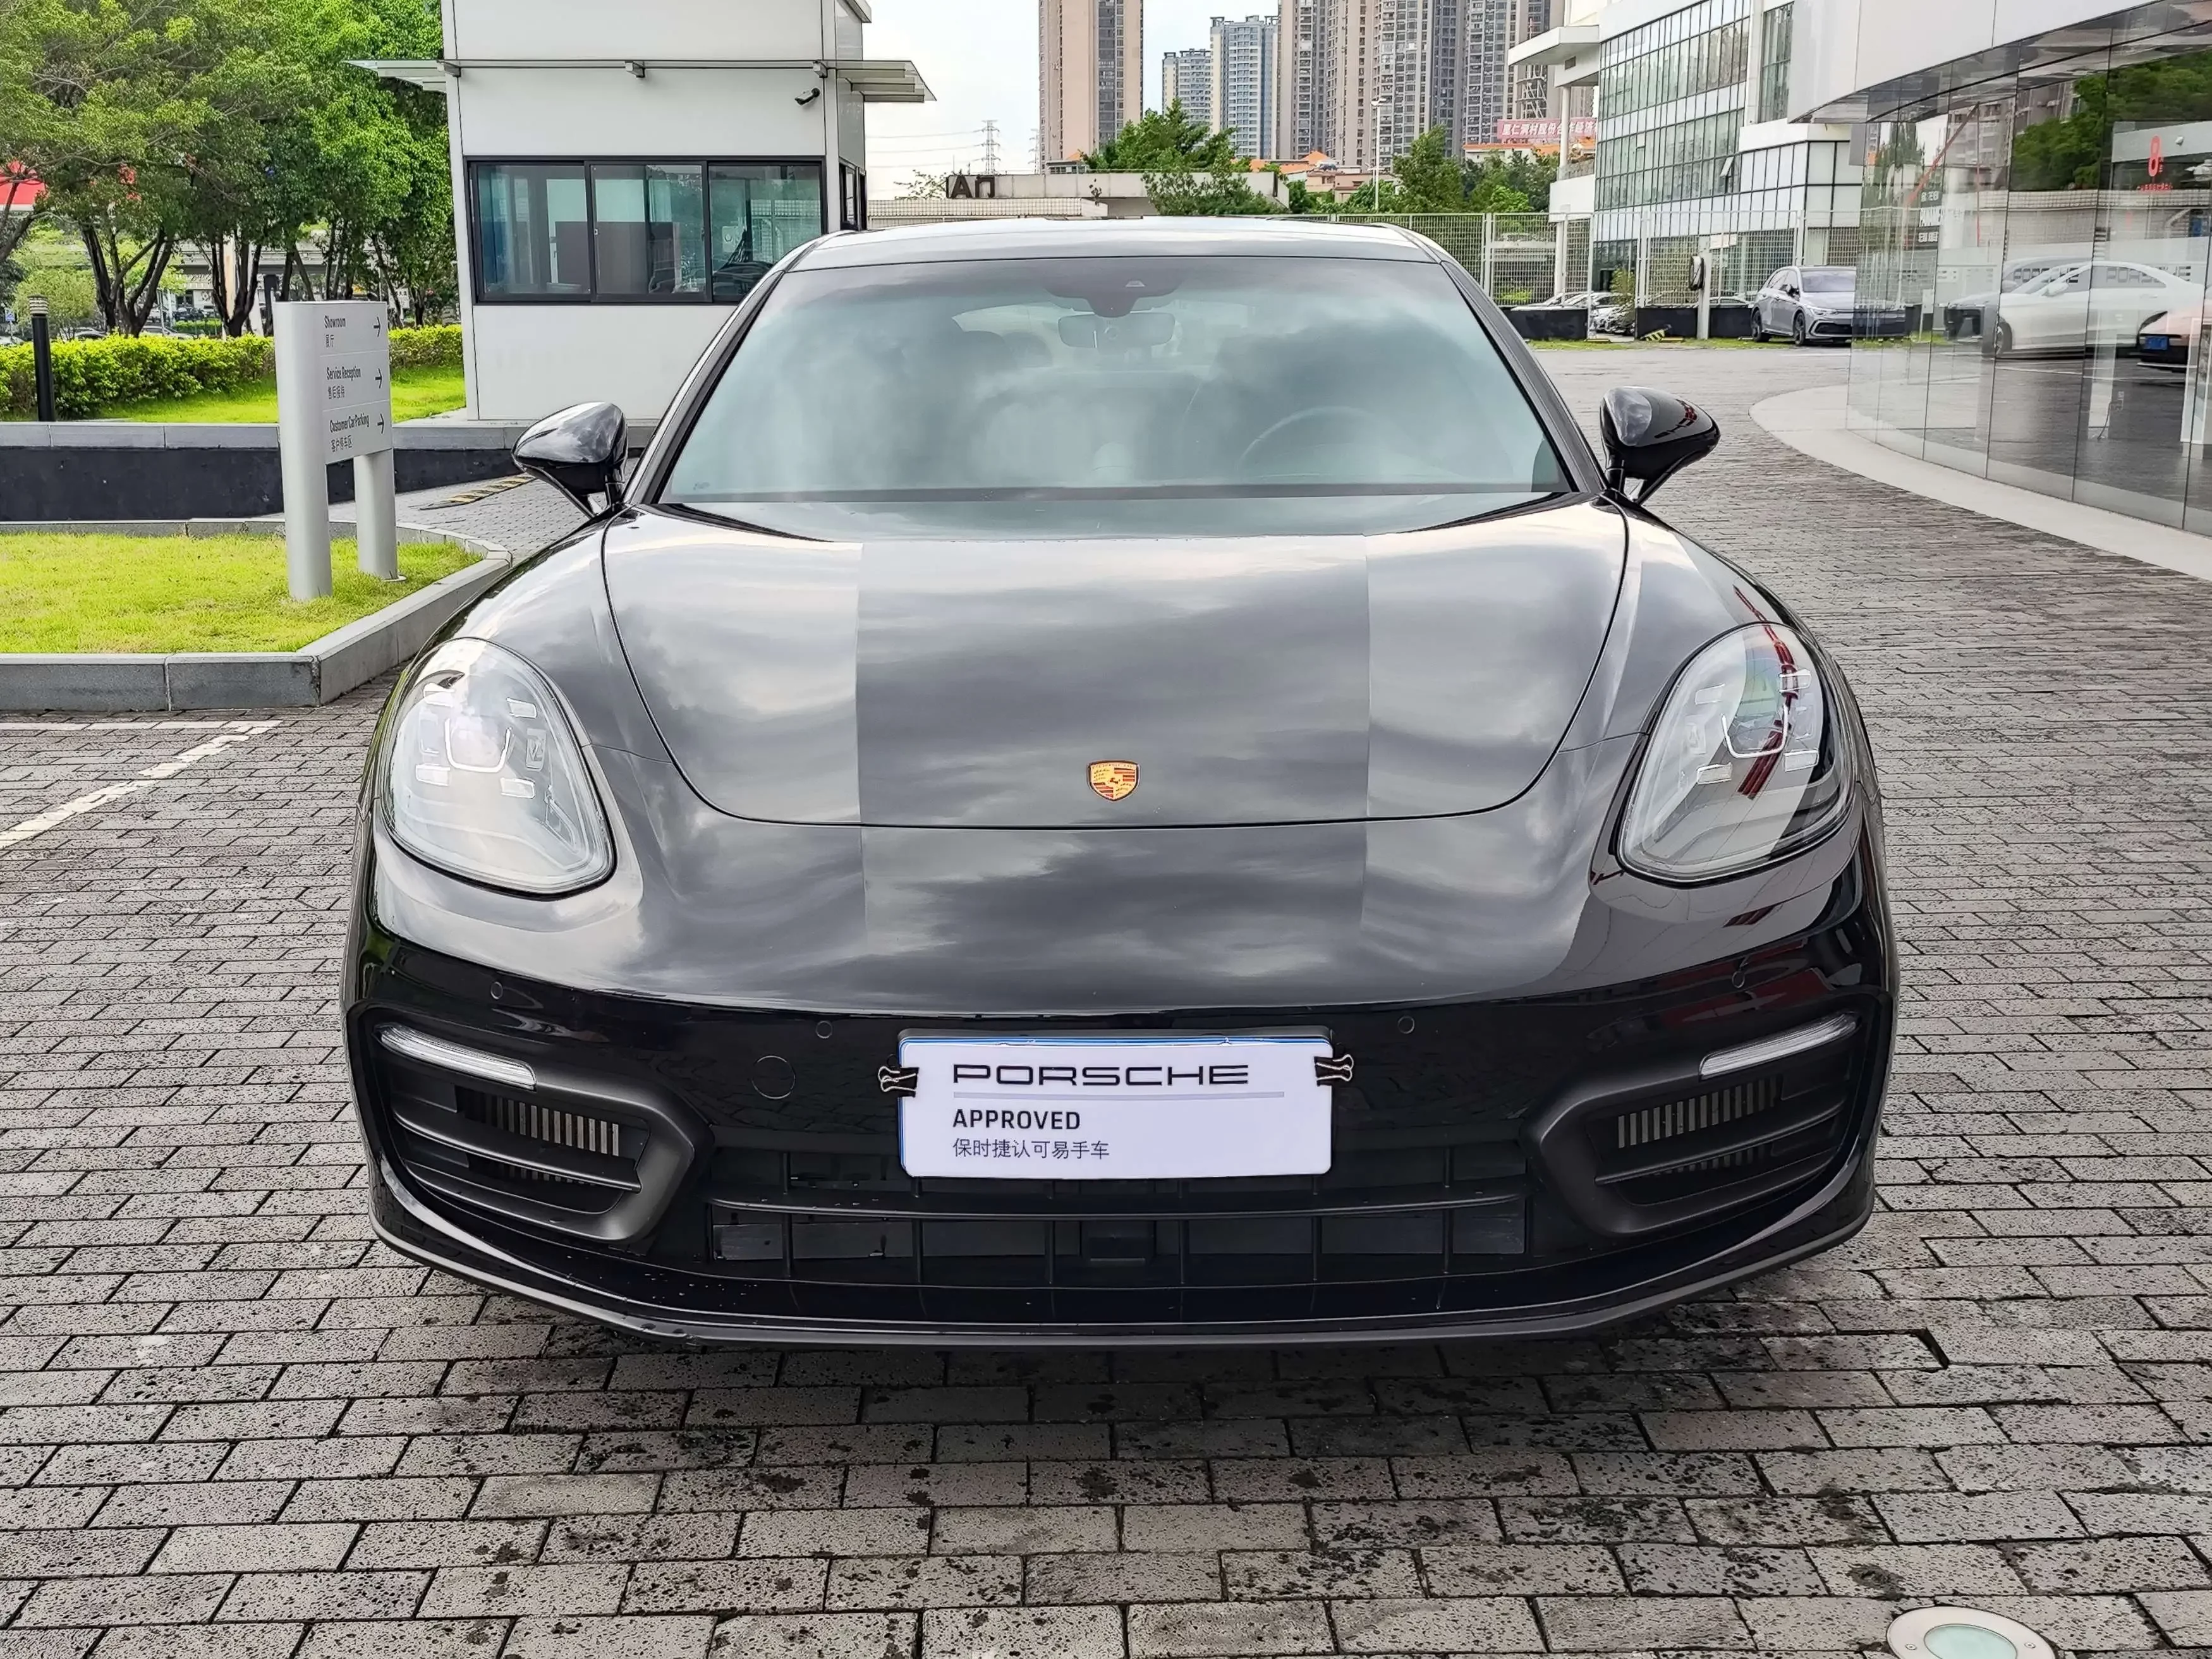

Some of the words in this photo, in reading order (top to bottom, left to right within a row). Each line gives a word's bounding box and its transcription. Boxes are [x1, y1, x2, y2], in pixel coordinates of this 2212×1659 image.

[324, 315, 346, 328] Showroom
[327, 367, 342, 380] Service
[342, 367, 361, 381] Reception
[330, 420, 348, 433] Customer
[355, 413, 370, 428] Parking
[952, 1064, 1249, 1086] PORSCHE
[952, 1109, 1081, 1130] APPROVED
[952, 1138, 1110, 1160] 保时捷认可易手车
